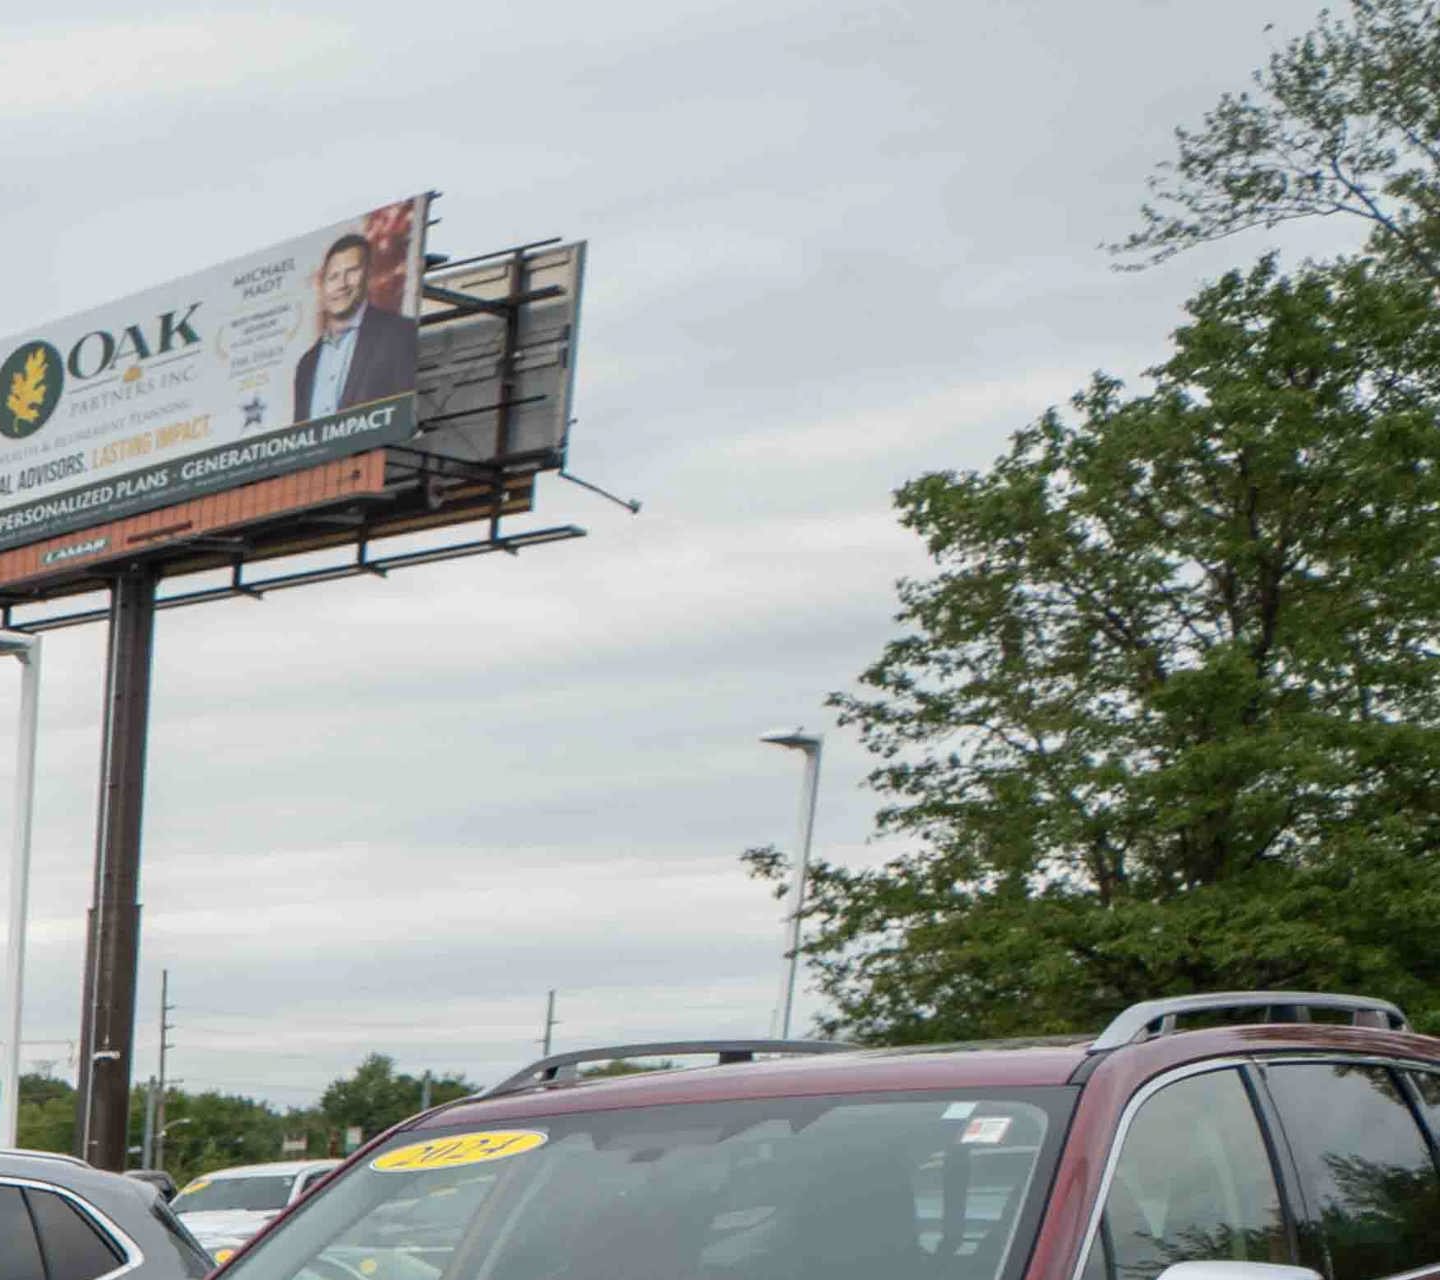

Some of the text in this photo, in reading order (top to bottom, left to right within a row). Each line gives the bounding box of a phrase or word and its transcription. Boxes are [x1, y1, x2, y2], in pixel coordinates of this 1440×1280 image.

[67, 301, 203, 380] OAK
[68, 377, 155, 418] PARTNERS
[92, 429, 154, 469] LASTING
[115, 469, 169, 501] PLANS
[180, 428, 317, 481] GENERATIONAL
[321, 406, 396, 441] IMPACT
